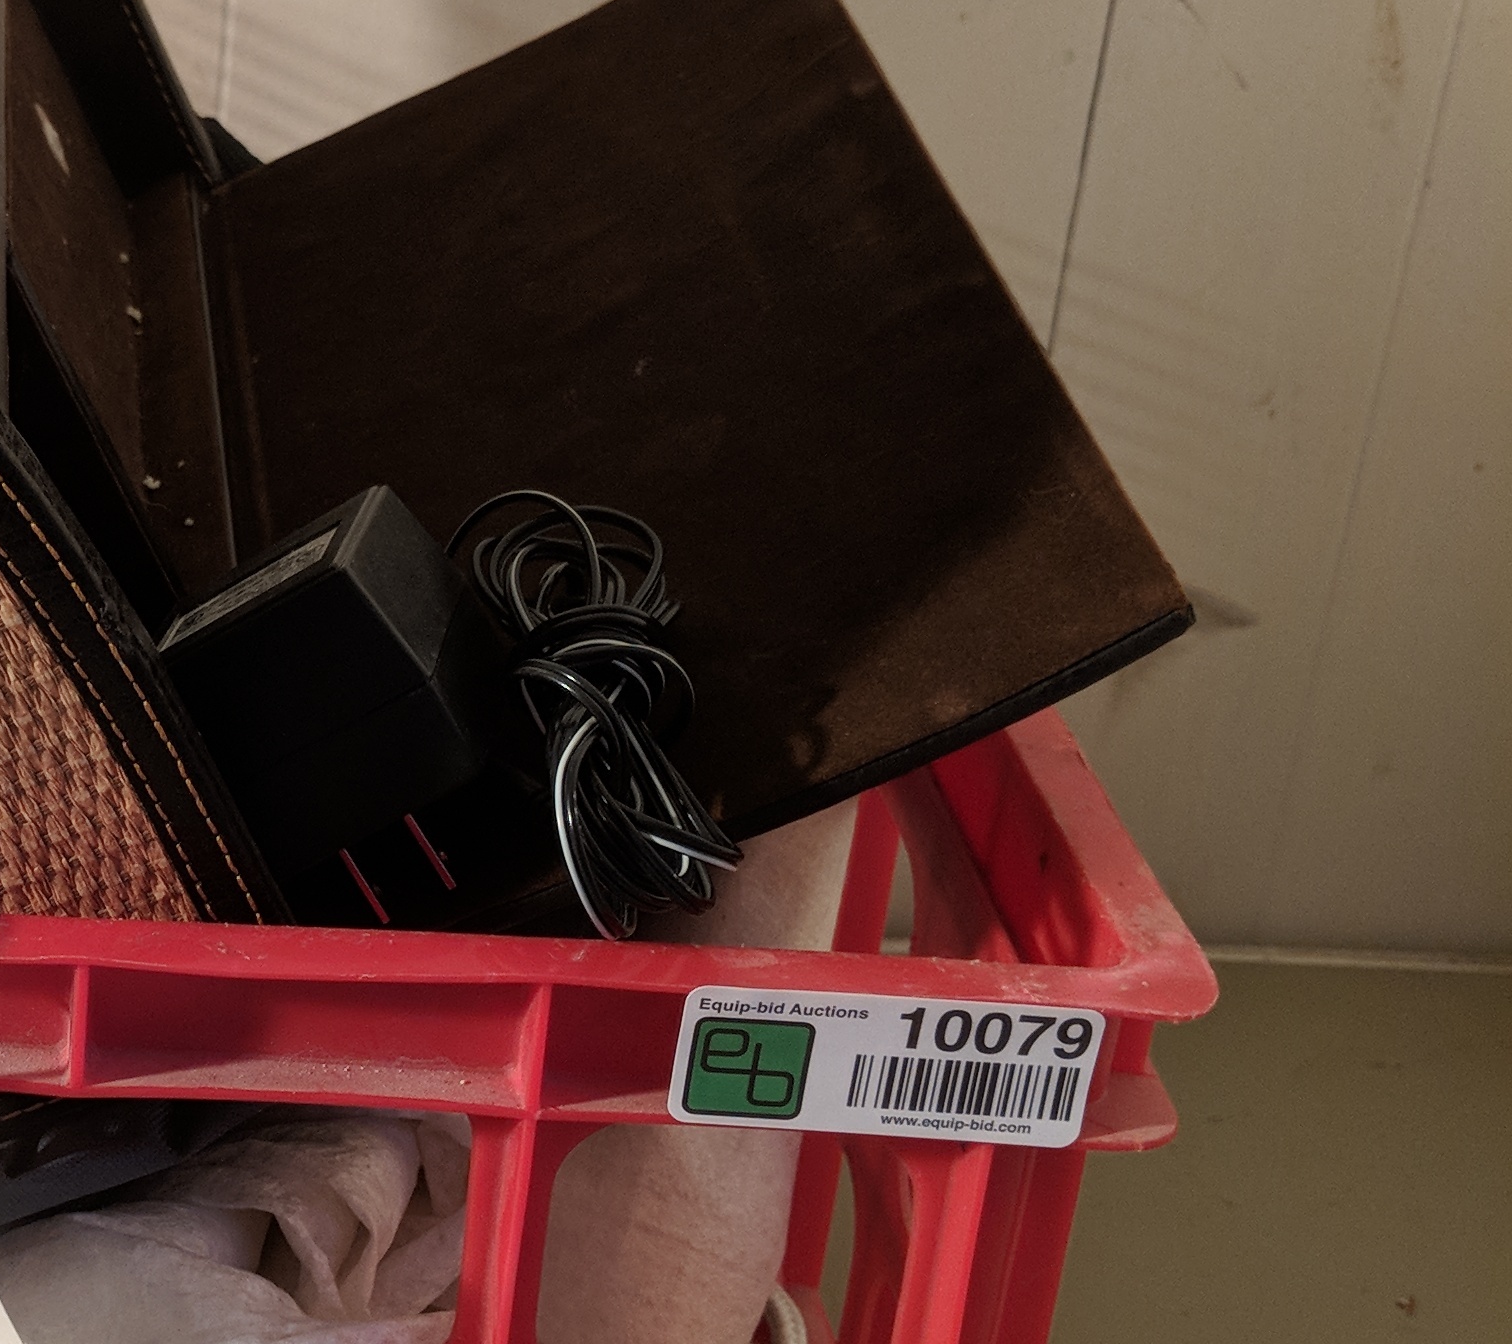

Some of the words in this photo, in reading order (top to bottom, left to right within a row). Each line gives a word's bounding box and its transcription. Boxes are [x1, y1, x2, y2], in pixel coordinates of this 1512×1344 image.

[698, 997, 785, 1016] Equip-bid
[788, 1002, 870, 1020] Auctions
[899, 1006, 1094, 1060] 10079
[880, 1113, 1032, 1135] www.equip-bid.com
